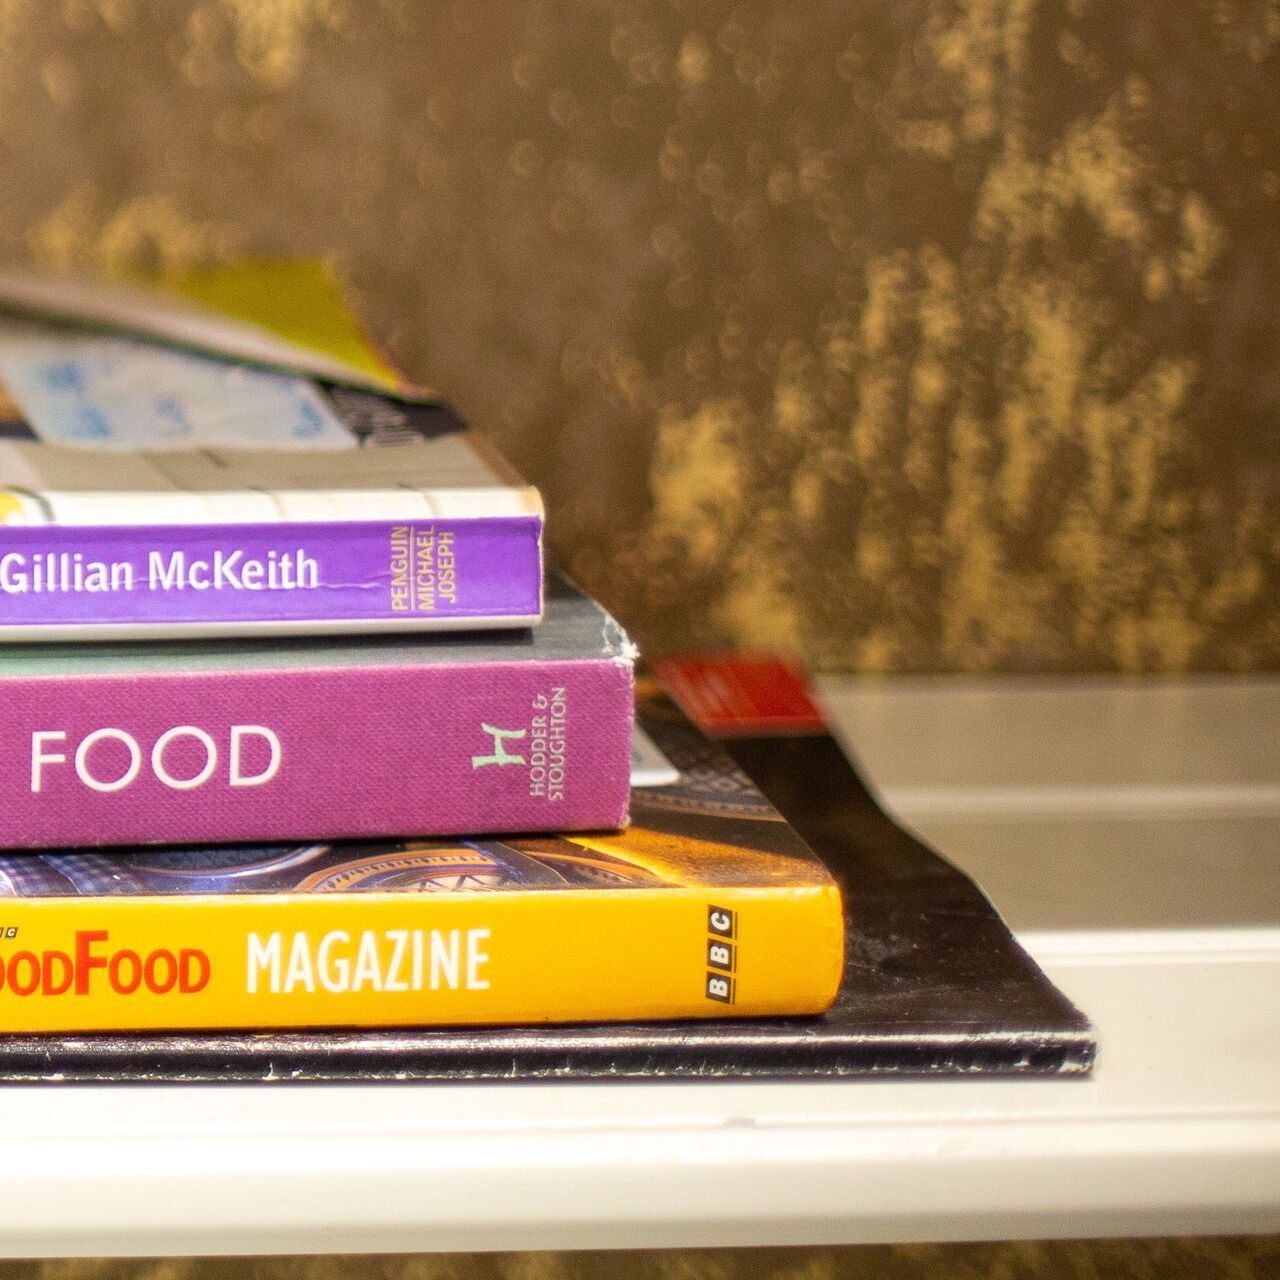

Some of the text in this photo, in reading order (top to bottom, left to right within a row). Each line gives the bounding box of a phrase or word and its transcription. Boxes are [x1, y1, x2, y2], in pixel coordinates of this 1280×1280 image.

[0, 549, 134, 595] Gillian
[148, 547, 320, 592] McKeith
[390, 525, 410, 612] PENGUIN
[417, 524, 436, 611] MICHAEL
[437, 530, 457, 605] JOSEPH
[30, 724, 282, 794] FOOD
[529, 693, 549, 797] HODDER &
[547, 686, 568, 802] STOUGHTON
[247, 928, 491, 994] MAGAZINE
[706, 905, 736, 1005] BBC
